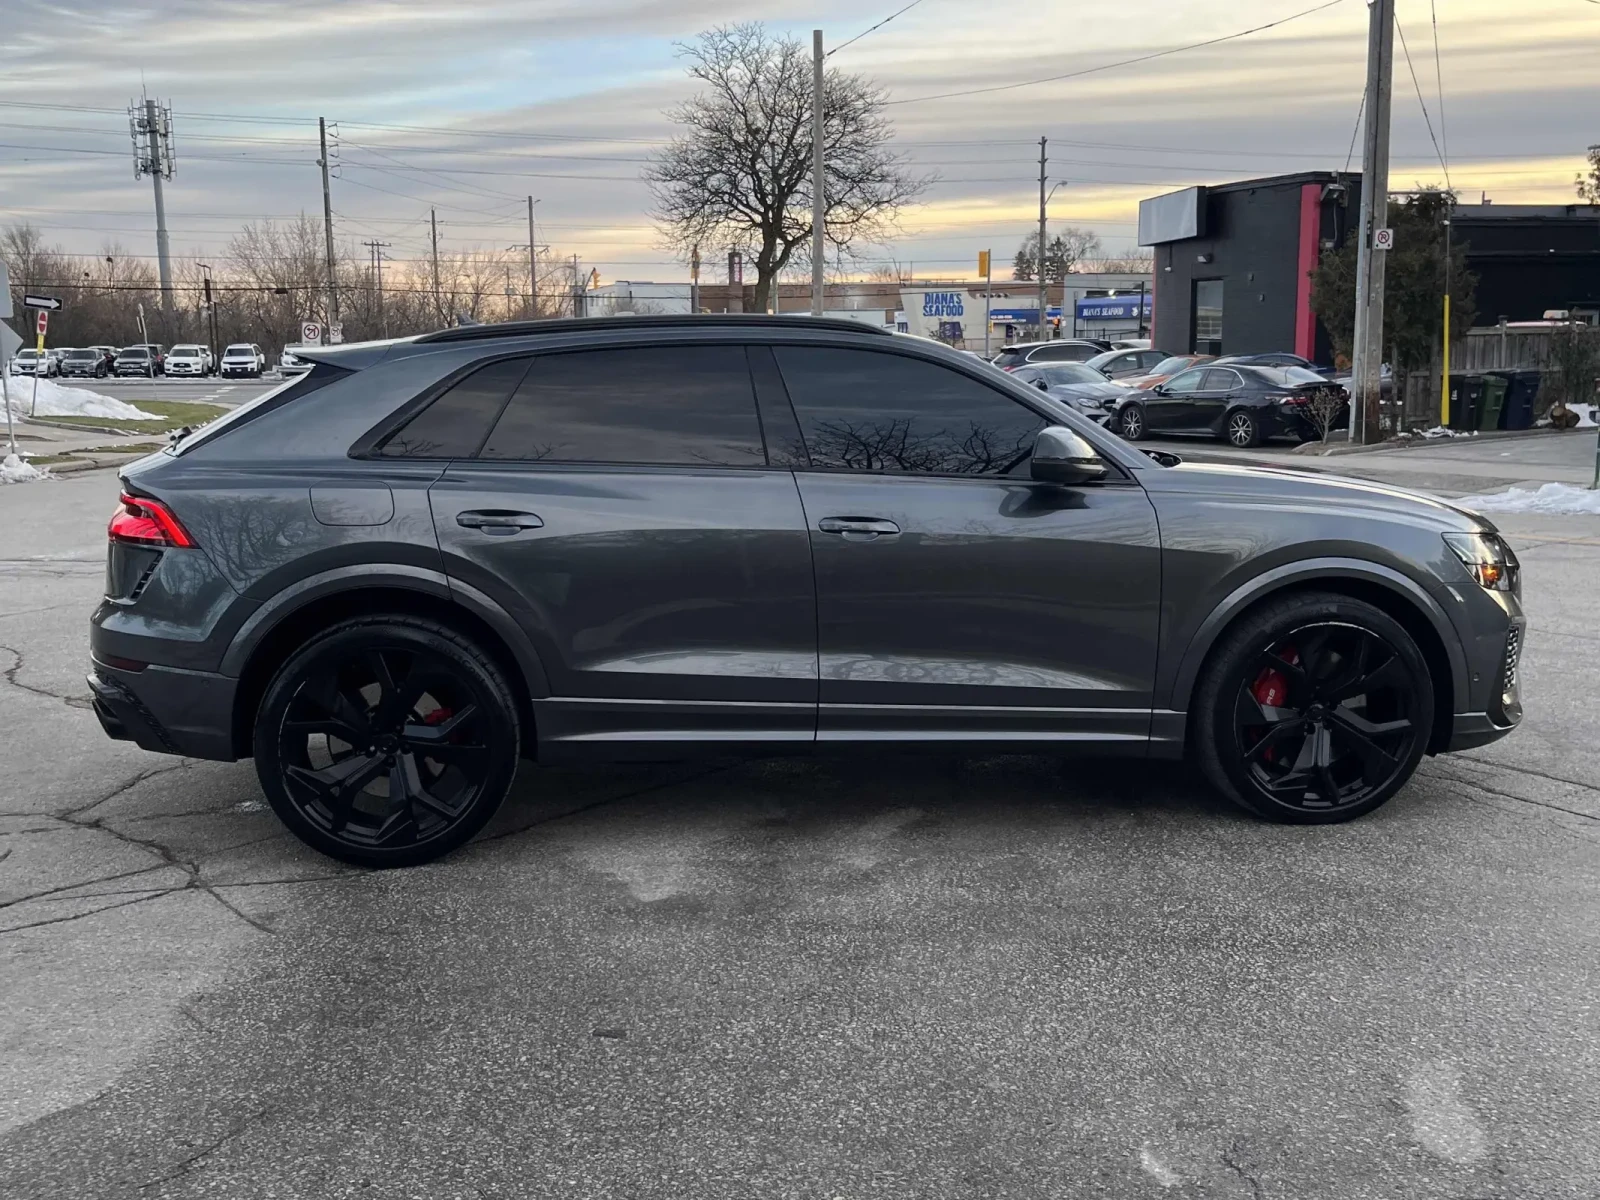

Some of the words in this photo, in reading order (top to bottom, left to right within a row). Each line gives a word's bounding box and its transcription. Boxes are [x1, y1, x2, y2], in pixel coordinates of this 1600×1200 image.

[924, 292, 962, 305] DIANA'S
[922, 305, 964, 317] SEAFOOD
[1101, 306, 1124, 316] SEAFOOD
